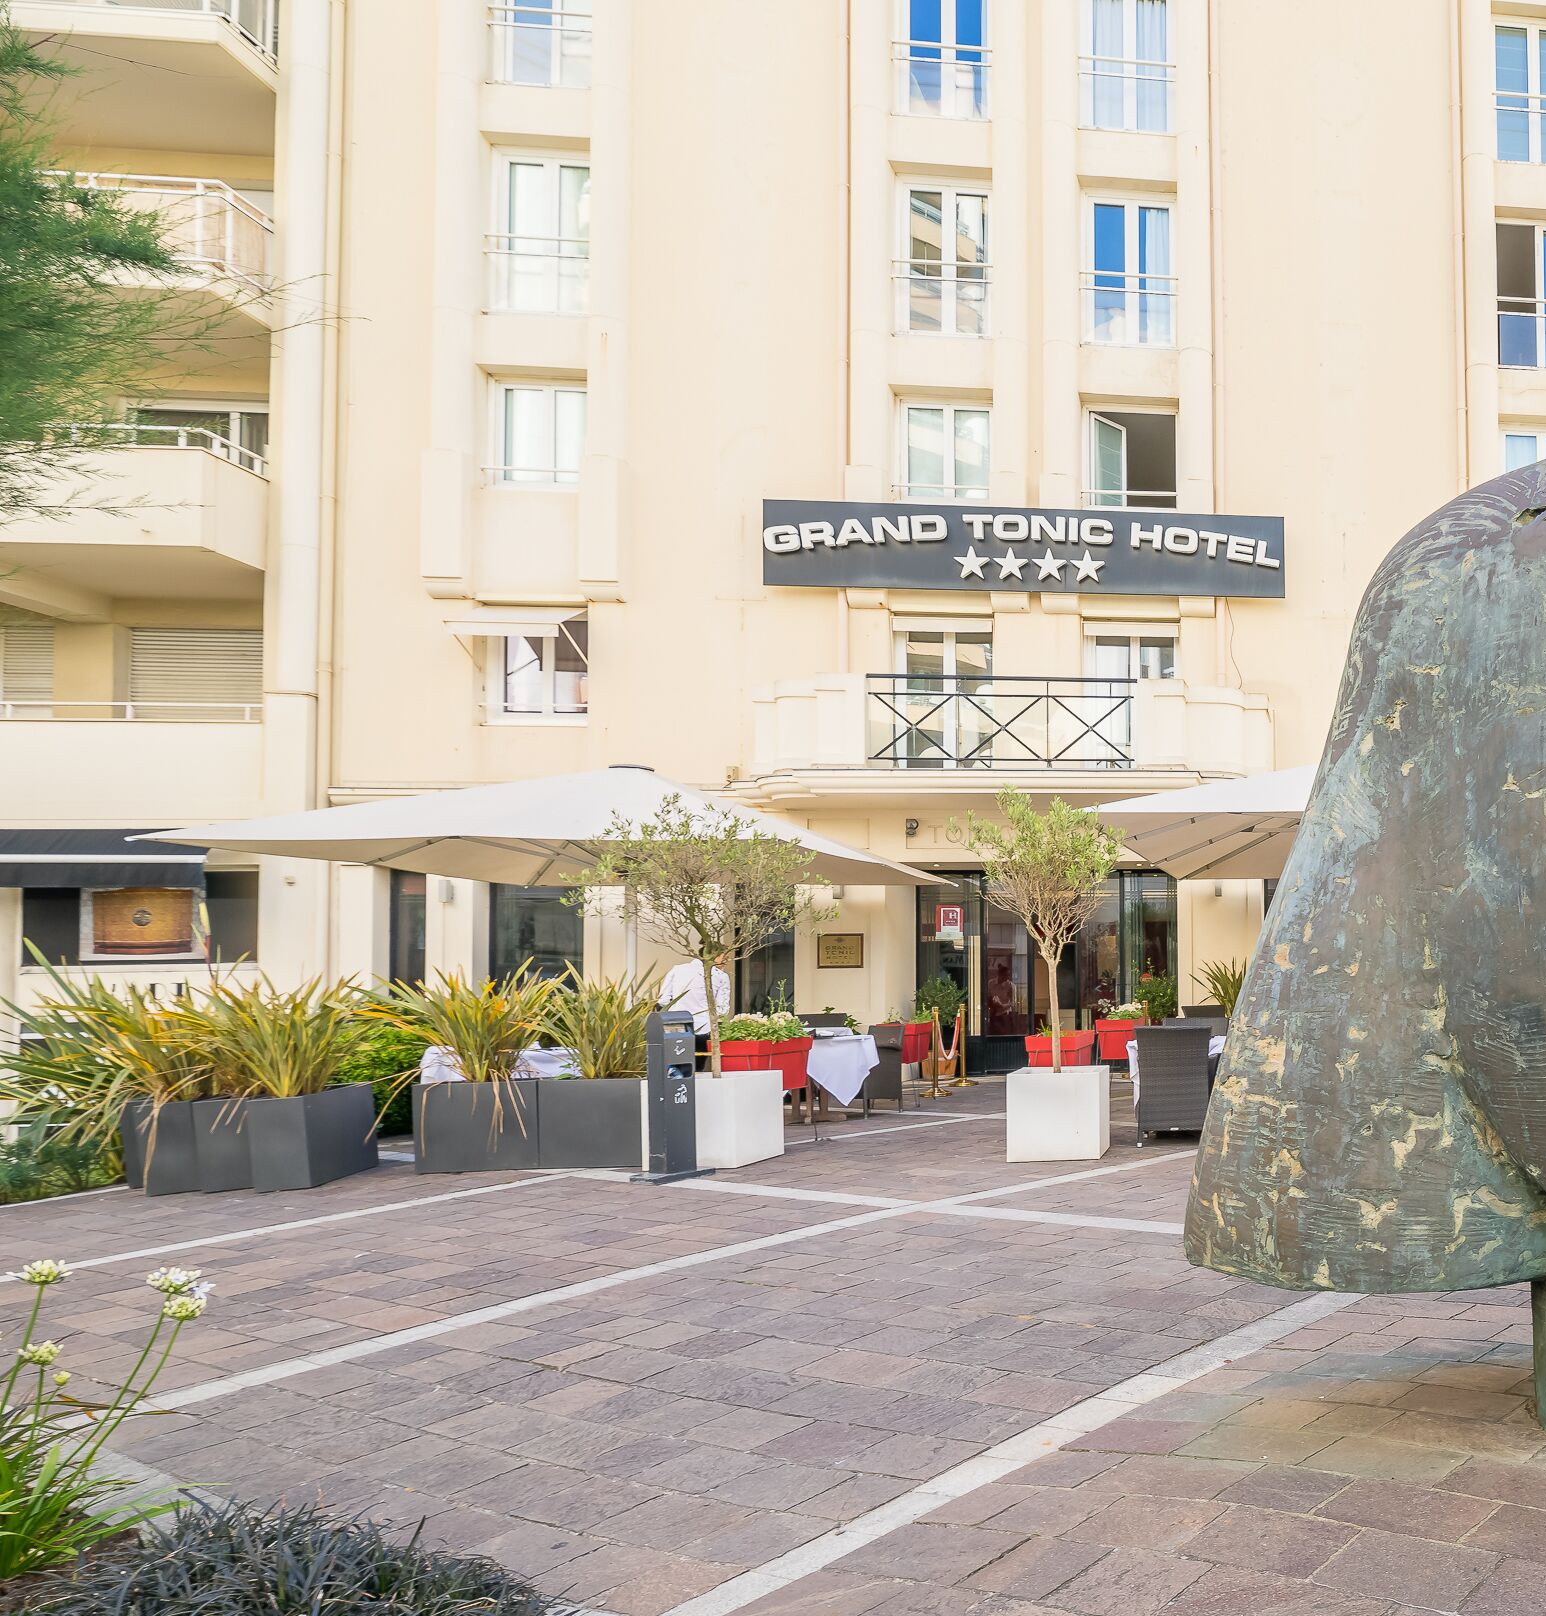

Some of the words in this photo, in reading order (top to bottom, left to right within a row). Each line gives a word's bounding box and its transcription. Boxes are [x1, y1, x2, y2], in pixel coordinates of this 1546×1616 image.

[763, 514, 948, 553] GRAND
[962, 513, 1114, 545] TONIC
[1129, 522, 1281, 569] HOTEL
